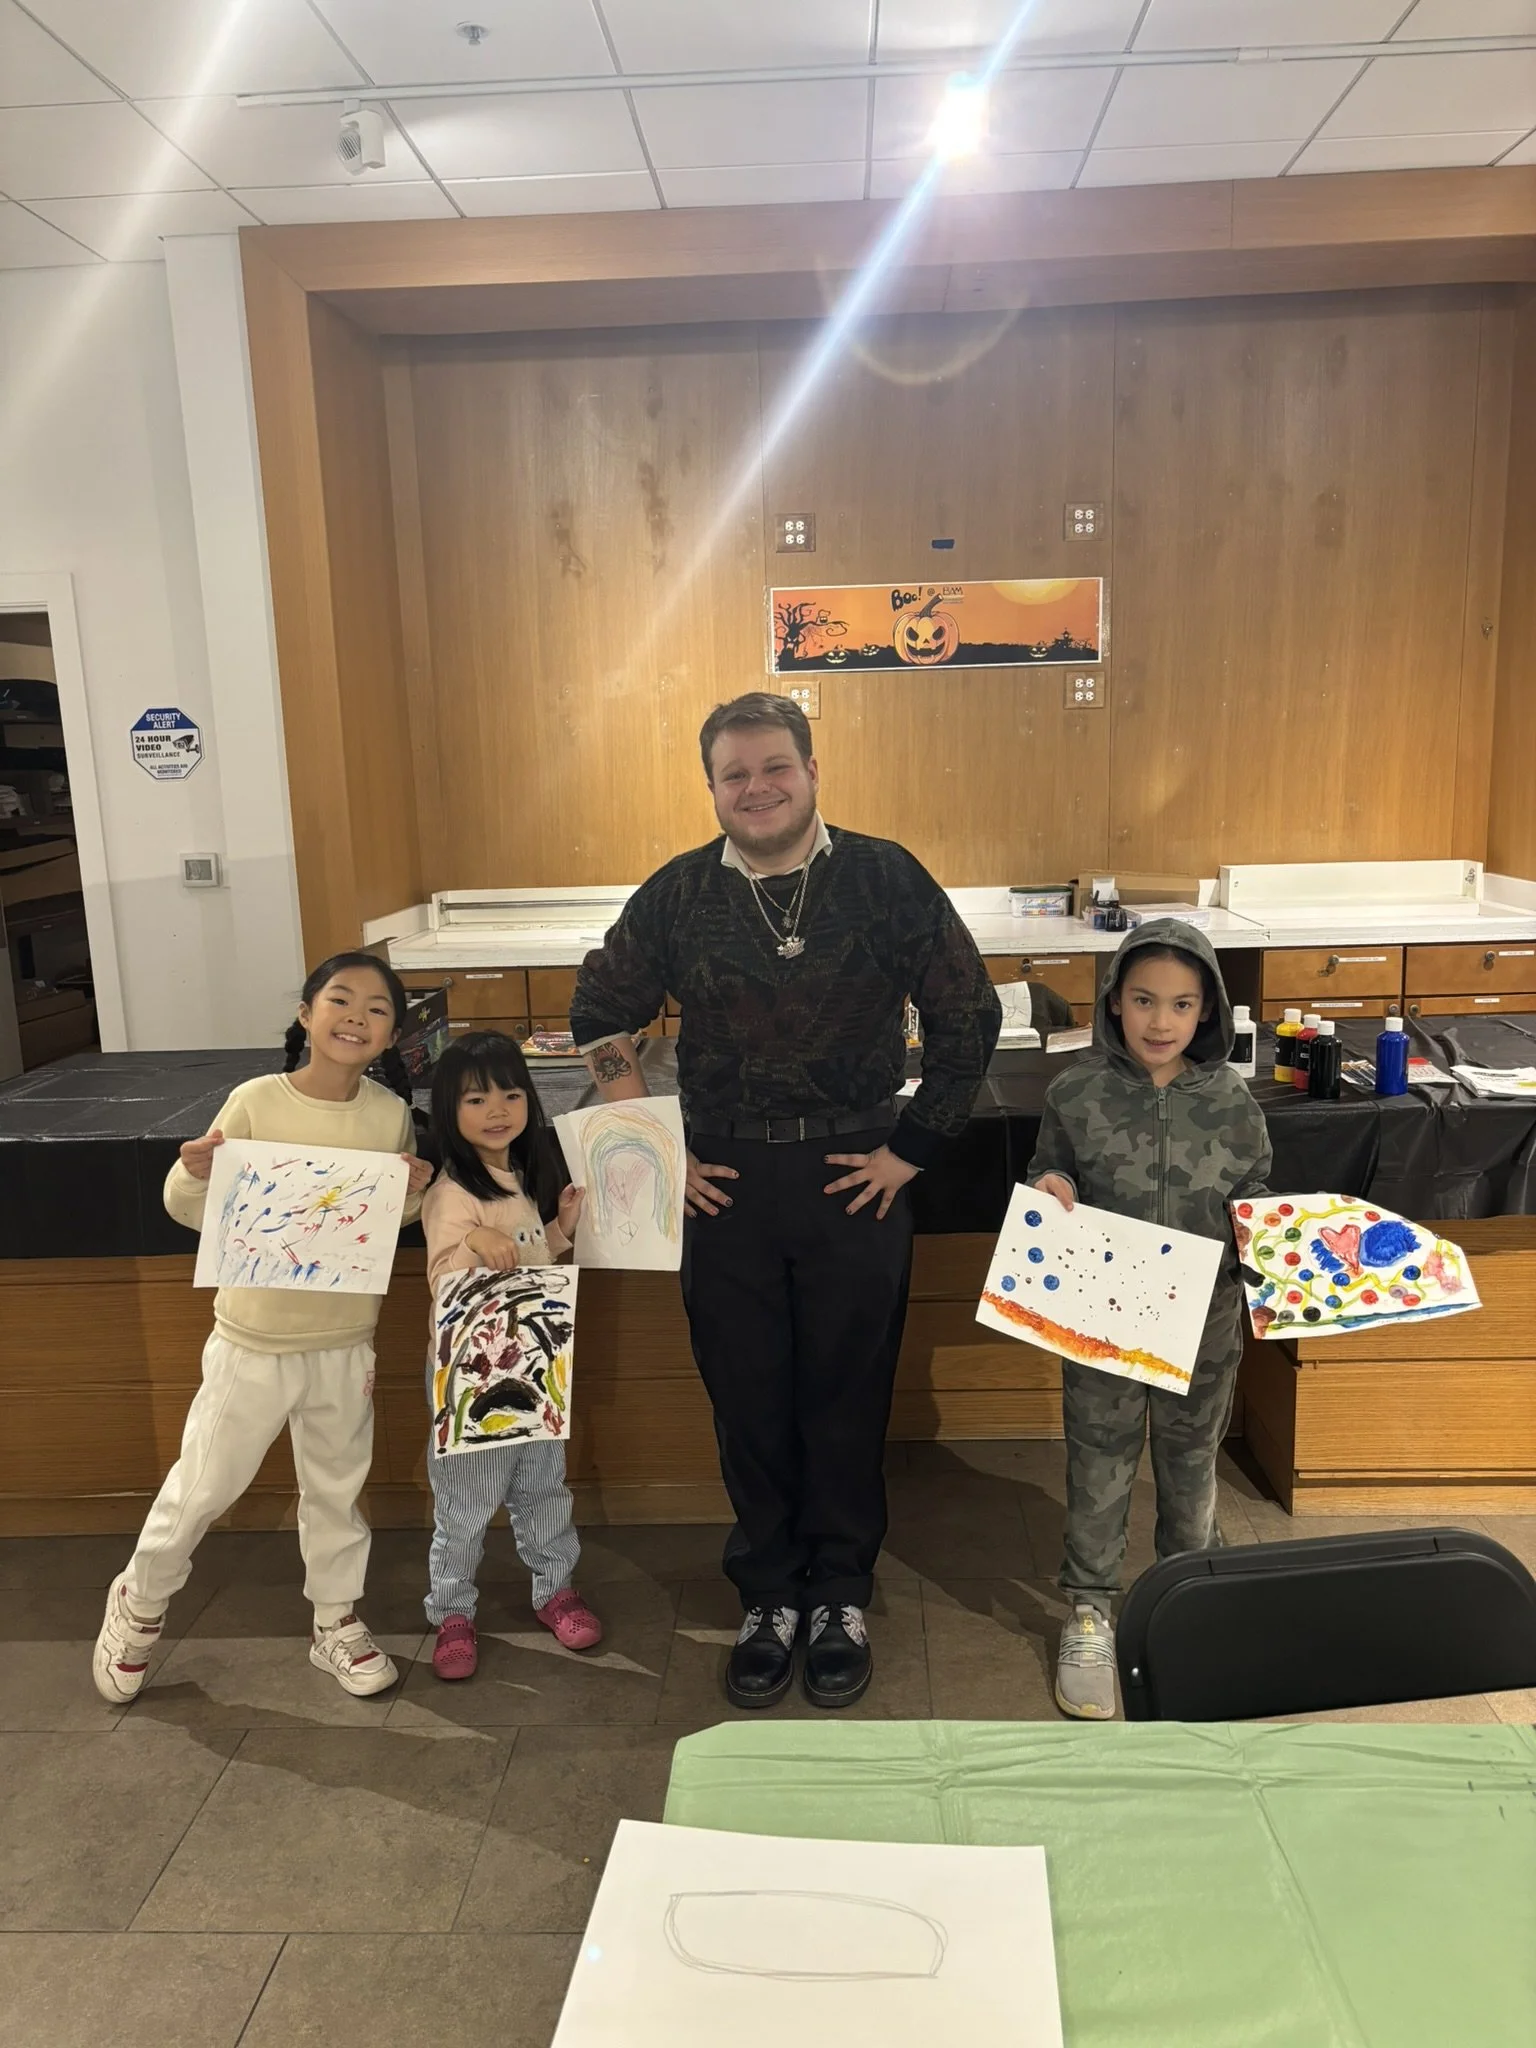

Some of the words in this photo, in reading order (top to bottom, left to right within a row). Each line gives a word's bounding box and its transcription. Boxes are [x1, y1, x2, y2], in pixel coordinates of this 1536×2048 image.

[891, 586, 922, 612] Boo!
[927, 588, 935, 596] @
[145, 713, 181, 722] SECURITY
[153, 721, 176, 729] ALERT
[147, 735, 171, 743] HOUR
[136, 744, 161, 752] VIDEO
